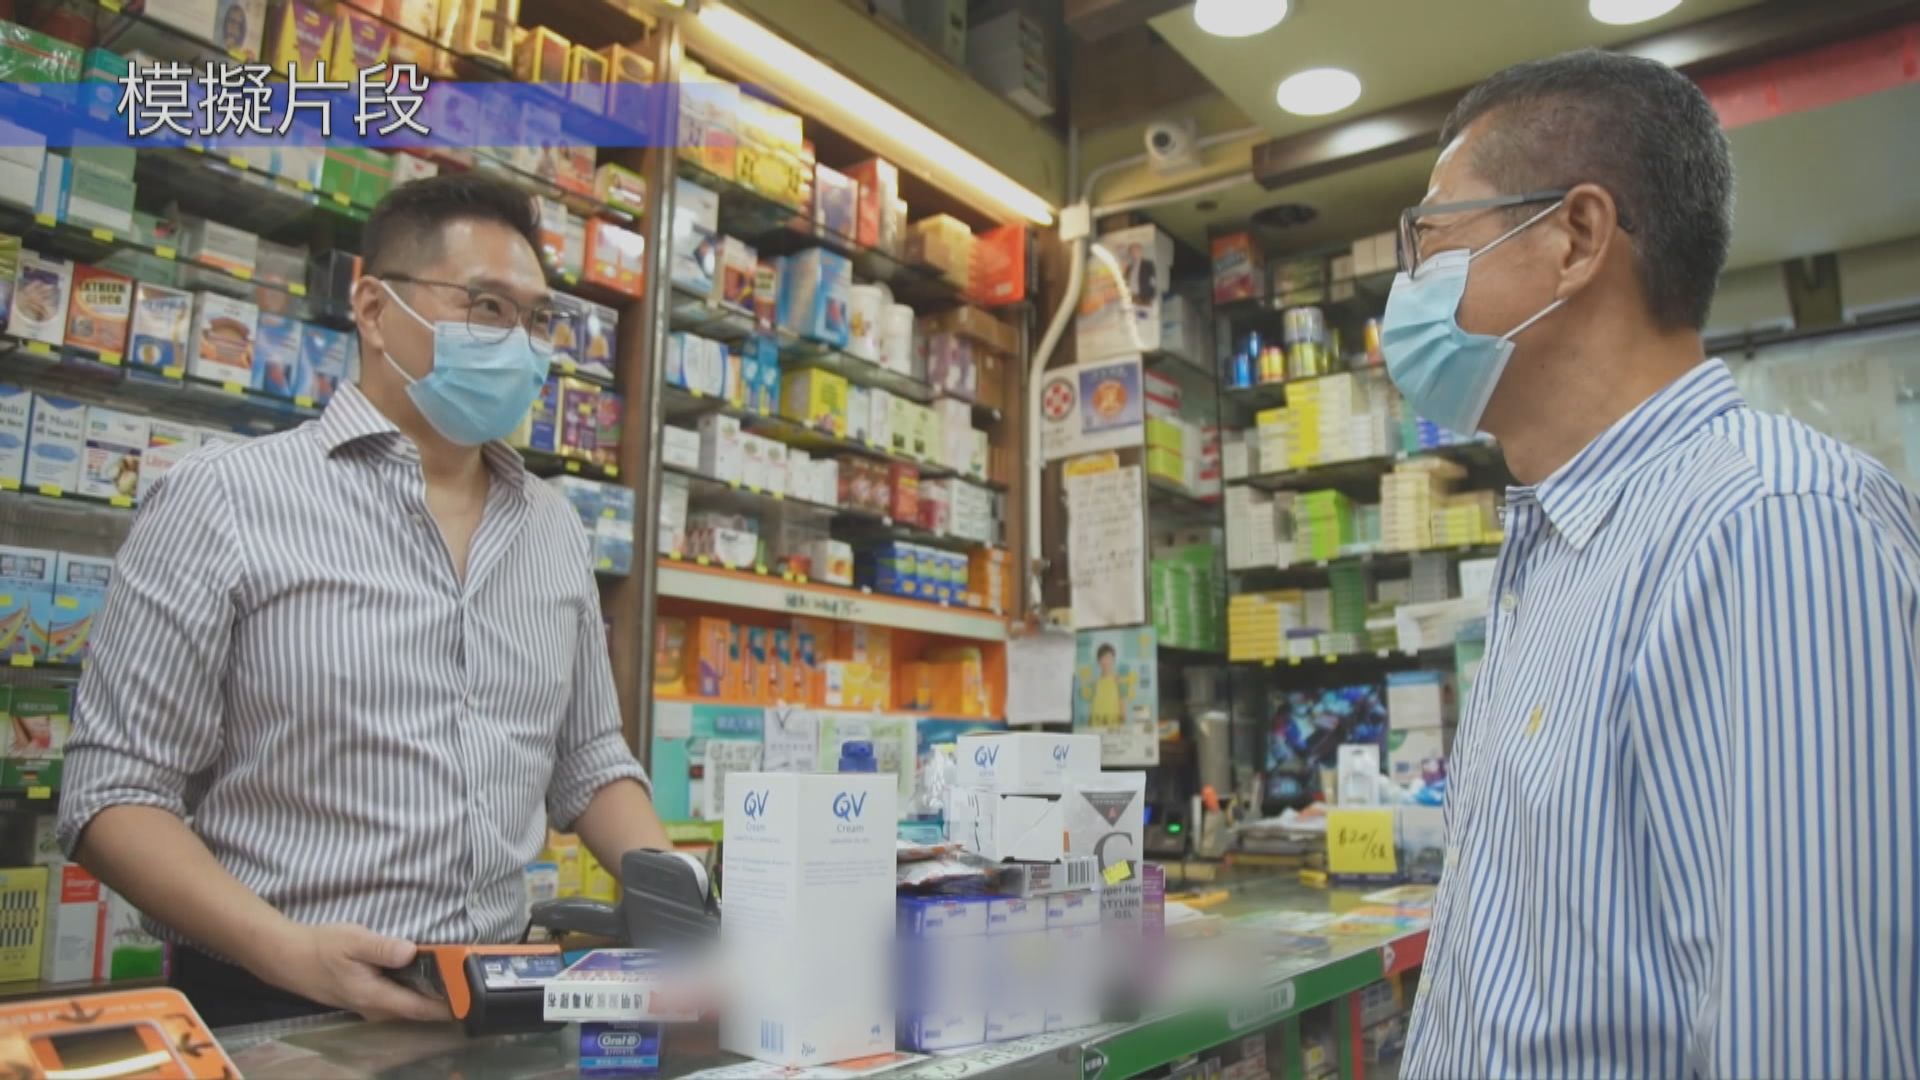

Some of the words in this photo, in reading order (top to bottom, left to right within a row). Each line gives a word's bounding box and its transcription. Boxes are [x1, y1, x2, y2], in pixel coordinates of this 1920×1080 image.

[974, 744, 999, 768] QV
[1053, 744, 1070, 761] QV
[744, 789, 770, 821] QV
[832, 790, 867, 822] QV
[836, 823, 865, 833] Cream
